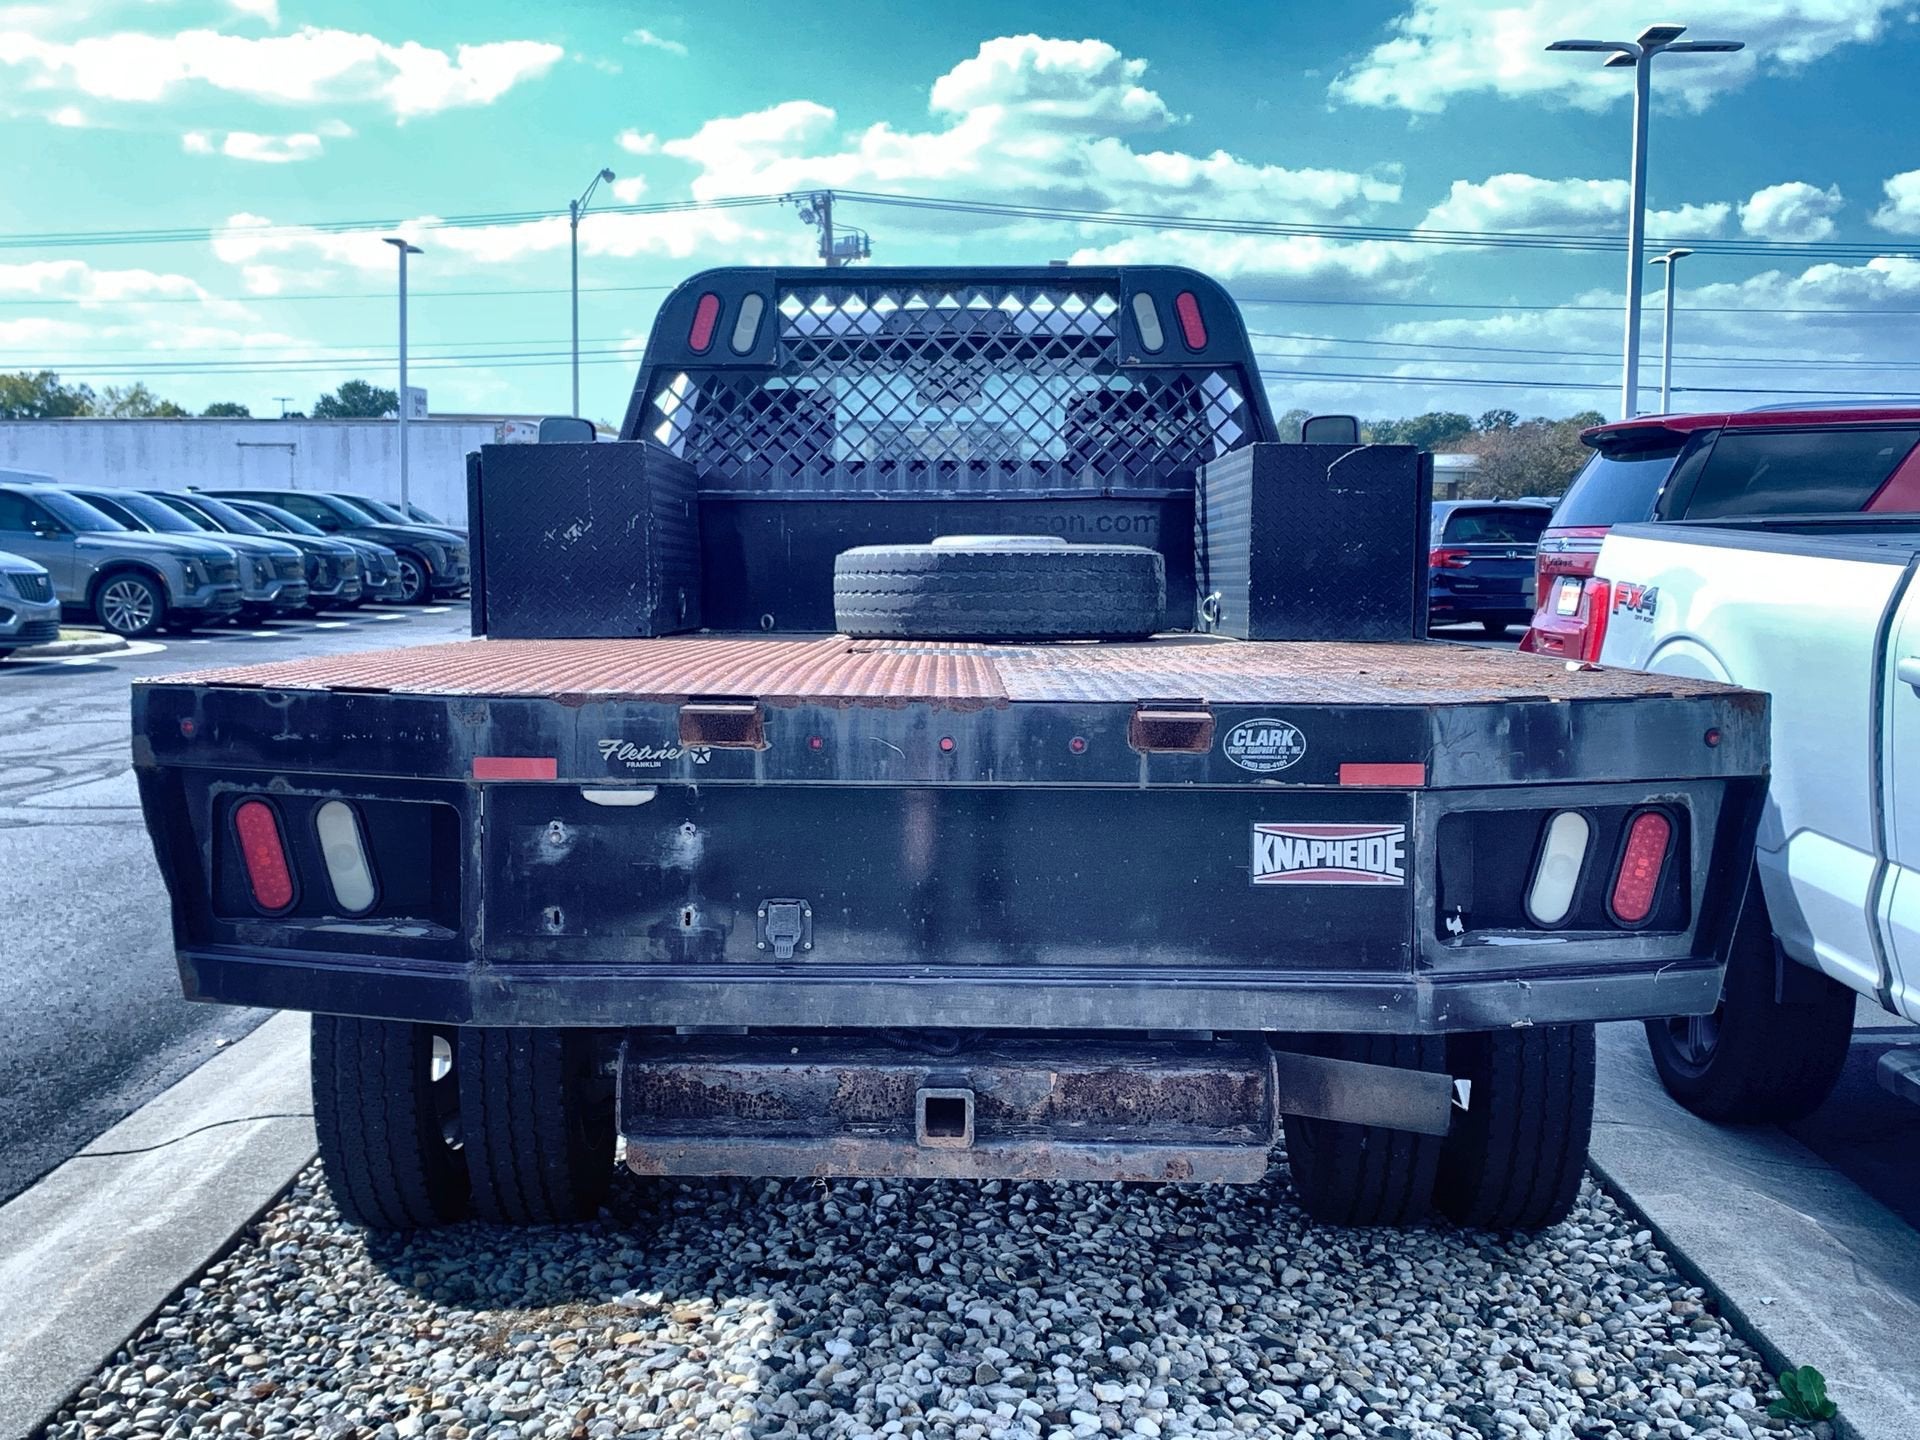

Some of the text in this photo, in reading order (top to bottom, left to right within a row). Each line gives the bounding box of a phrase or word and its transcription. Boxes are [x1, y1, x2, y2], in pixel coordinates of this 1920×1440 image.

[1612, 580, 1659, 616] FX4
[1233, 729, 1296, 746] CLARK
[1253, 832, 1405, 877] KNAPHEIDE
